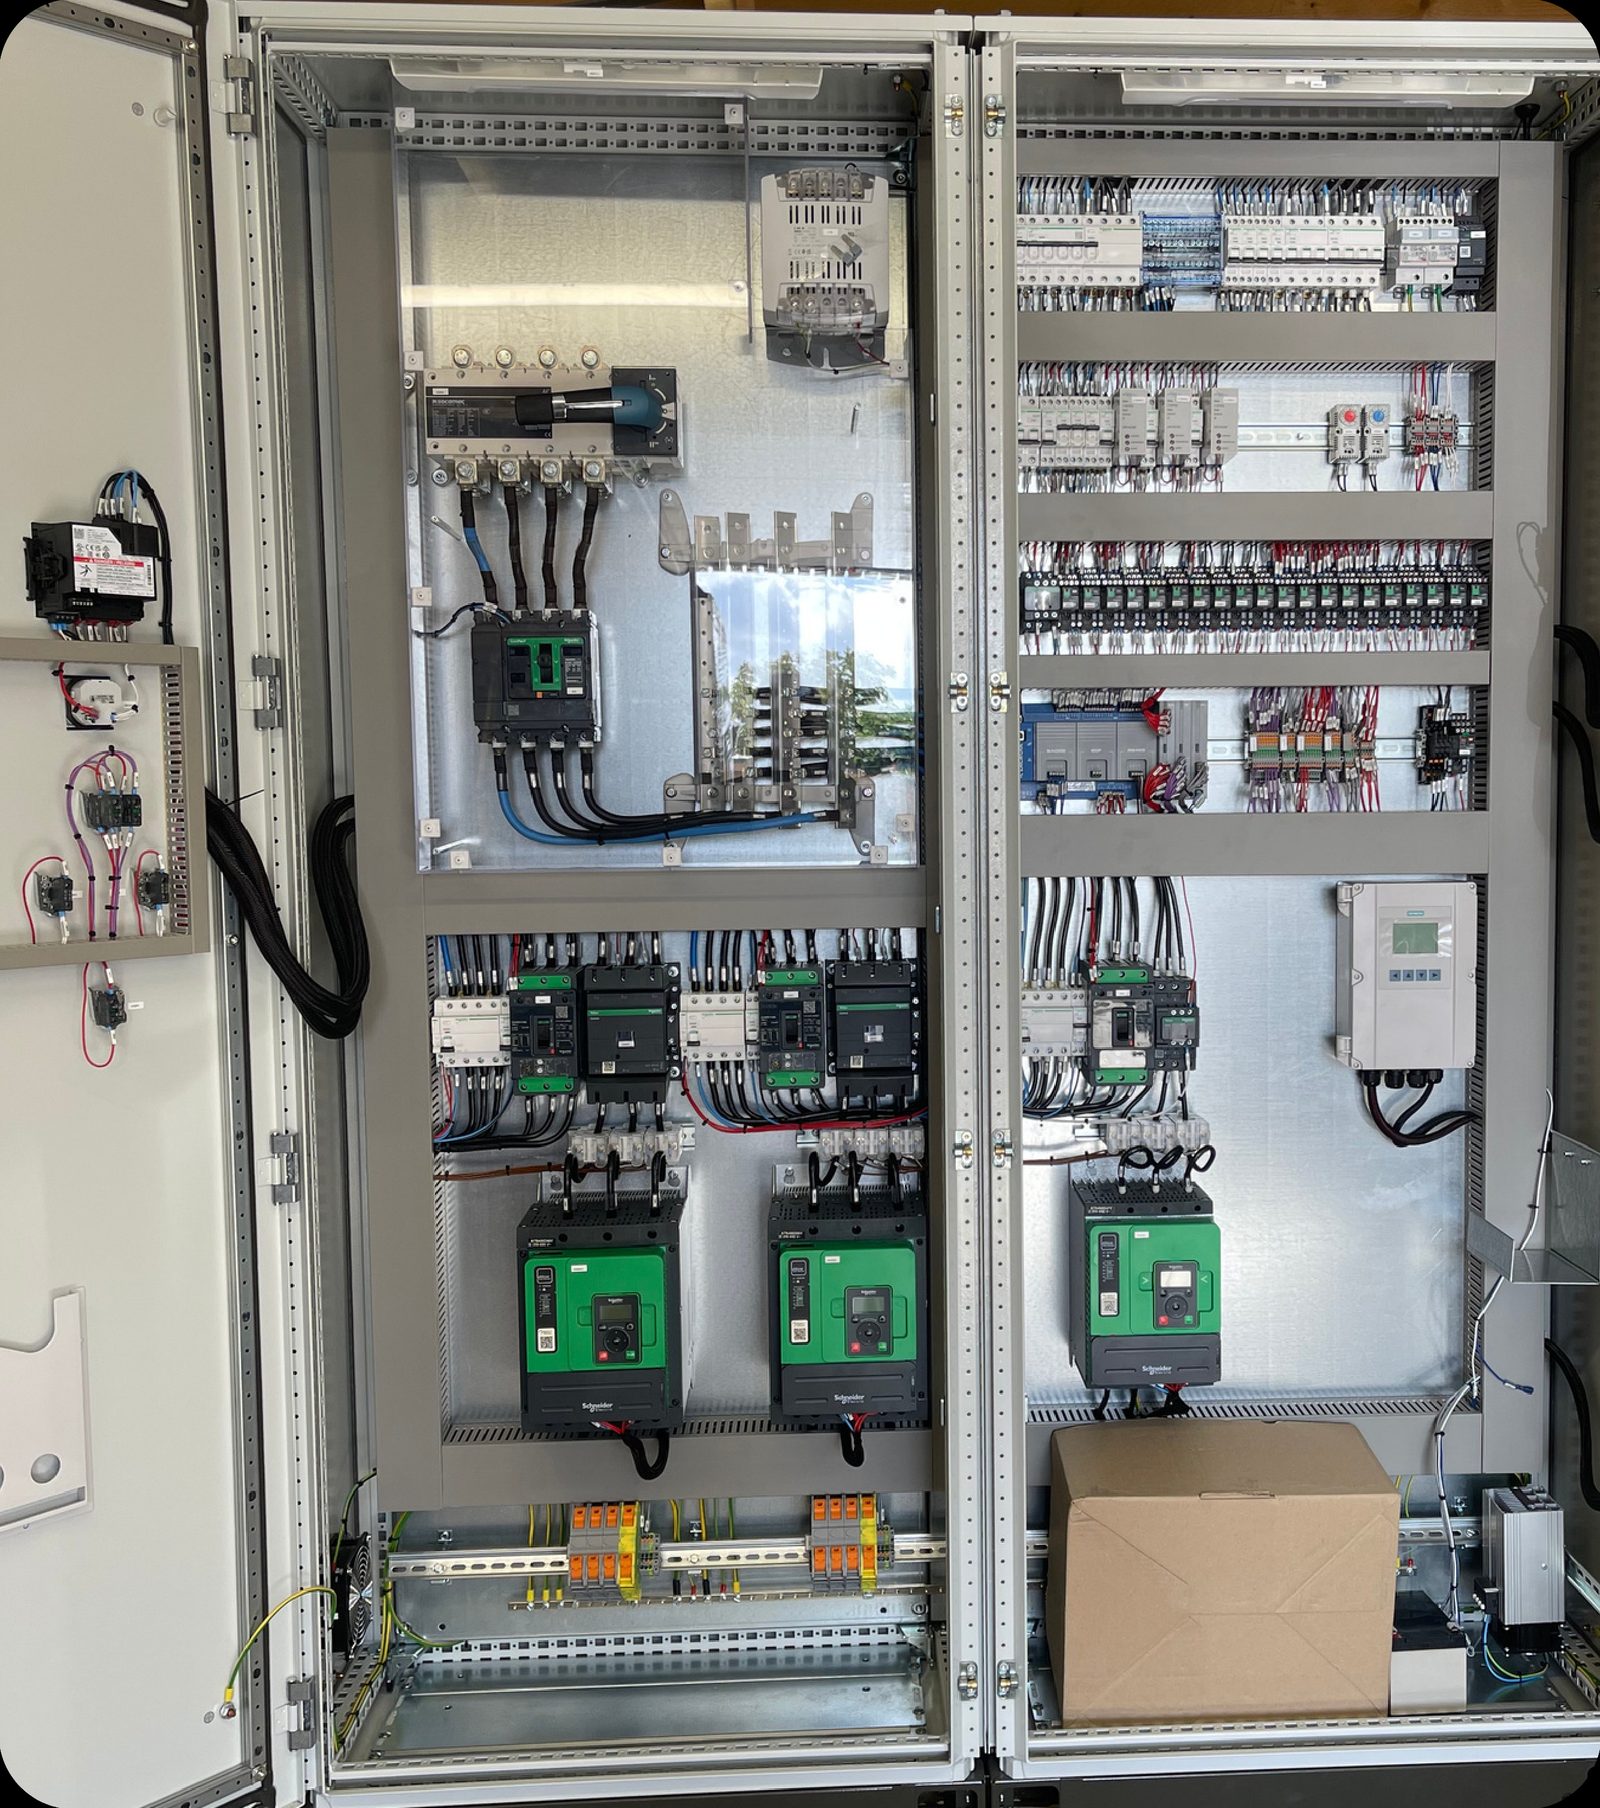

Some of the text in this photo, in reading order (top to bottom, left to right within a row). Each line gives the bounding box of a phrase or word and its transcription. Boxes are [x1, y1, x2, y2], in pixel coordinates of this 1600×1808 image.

[1142, 1365, 1172, 1375] Schneider
[834, 1394, 864, 1404] Schneider
[582, 1402, 613, 1413] Schneider
